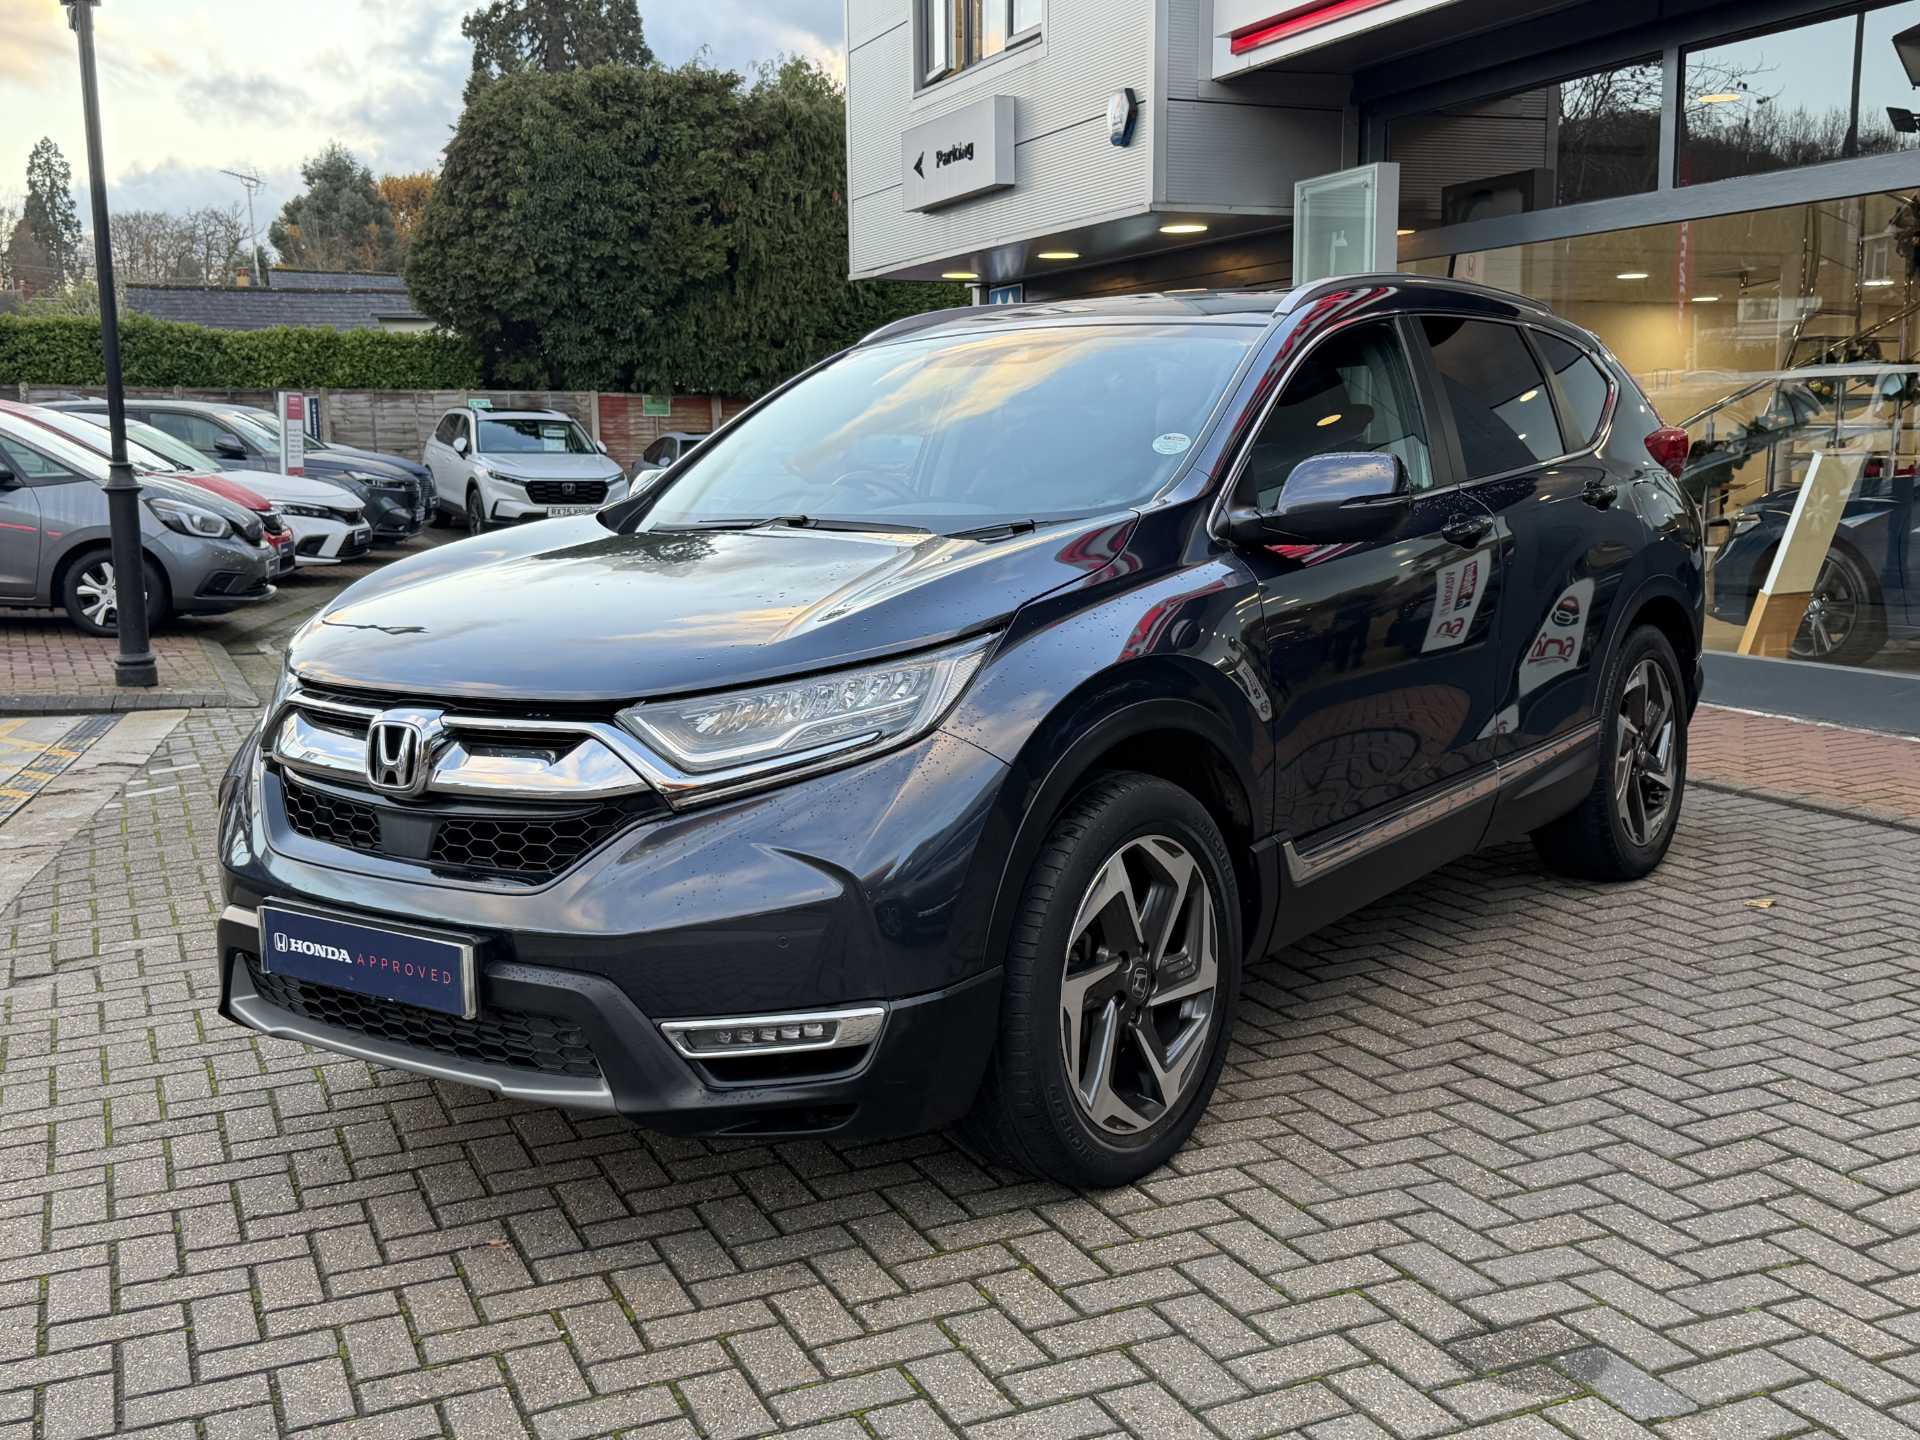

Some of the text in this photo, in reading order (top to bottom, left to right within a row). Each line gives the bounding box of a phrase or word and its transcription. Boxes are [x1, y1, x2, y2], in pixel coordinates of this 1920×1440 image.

[936, 141, 975, 169] Parking
[289, 937, 353, 964] HONDA
[356, 953, 452, 984] APPROVED
